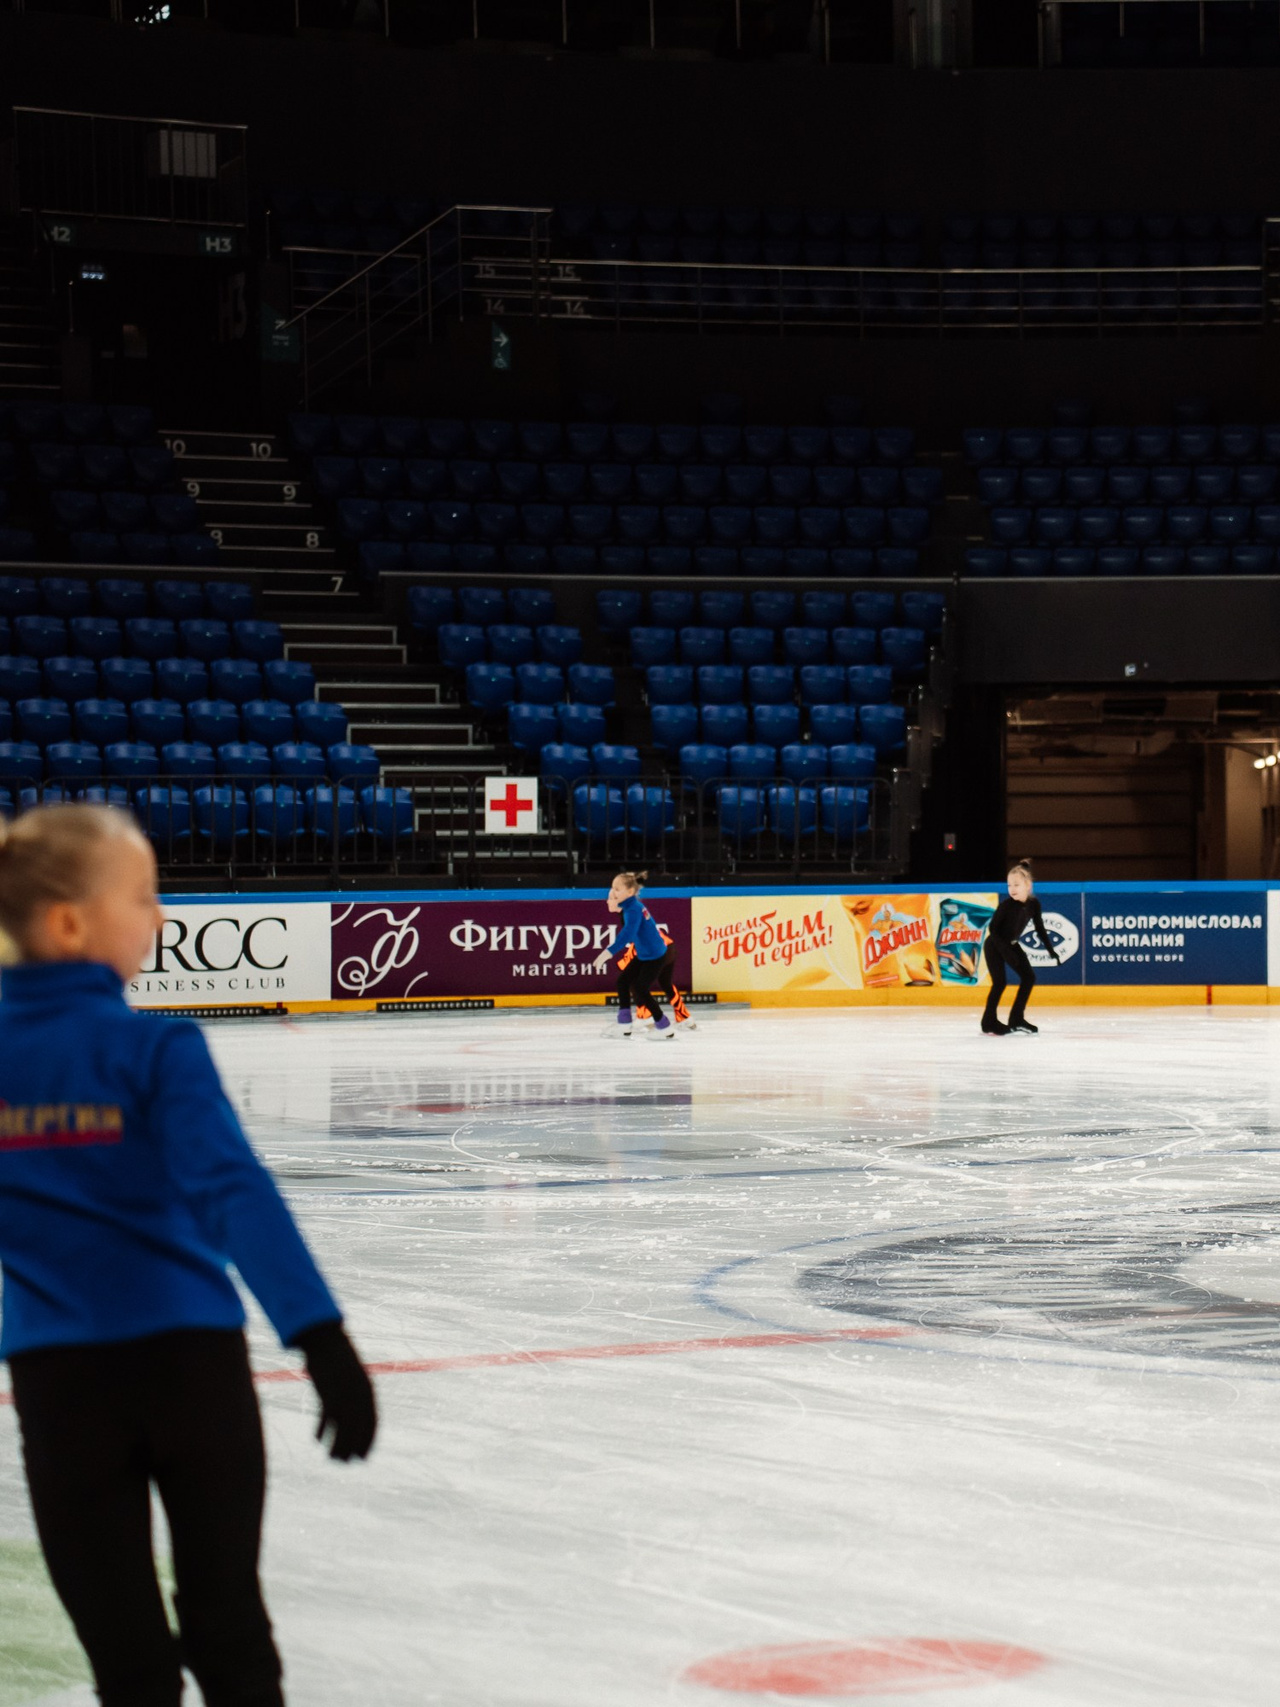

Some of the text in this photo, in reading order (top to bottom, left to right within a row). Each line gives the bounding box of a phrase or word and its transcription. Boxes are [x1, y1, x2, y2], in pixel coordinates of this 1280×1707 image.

[164, 438, 272, 459] 10 10
[186, 482, 297, 500] 9 9
[306, 532, 320, 549] 8
[330, 576, 344, 593] 7
[1091, 915, 1263, 930] РЫБОПРОМЫСЛОВАЯ
[140, 917, 289, 974] RCC
[449, 919, 670, 960] Фигури
[710, 909, 825, 965] любим
[1091, 934, 1185, 948] КОМПАНИЯ
[753, 925, 833, 968] и едим!
[1092, 954, 1185, 963] ОХОТСКОЕ МОРЕ
[511, 963, 608, 977] магазин
[130, 977, 286, 992] SINESS CLUB
